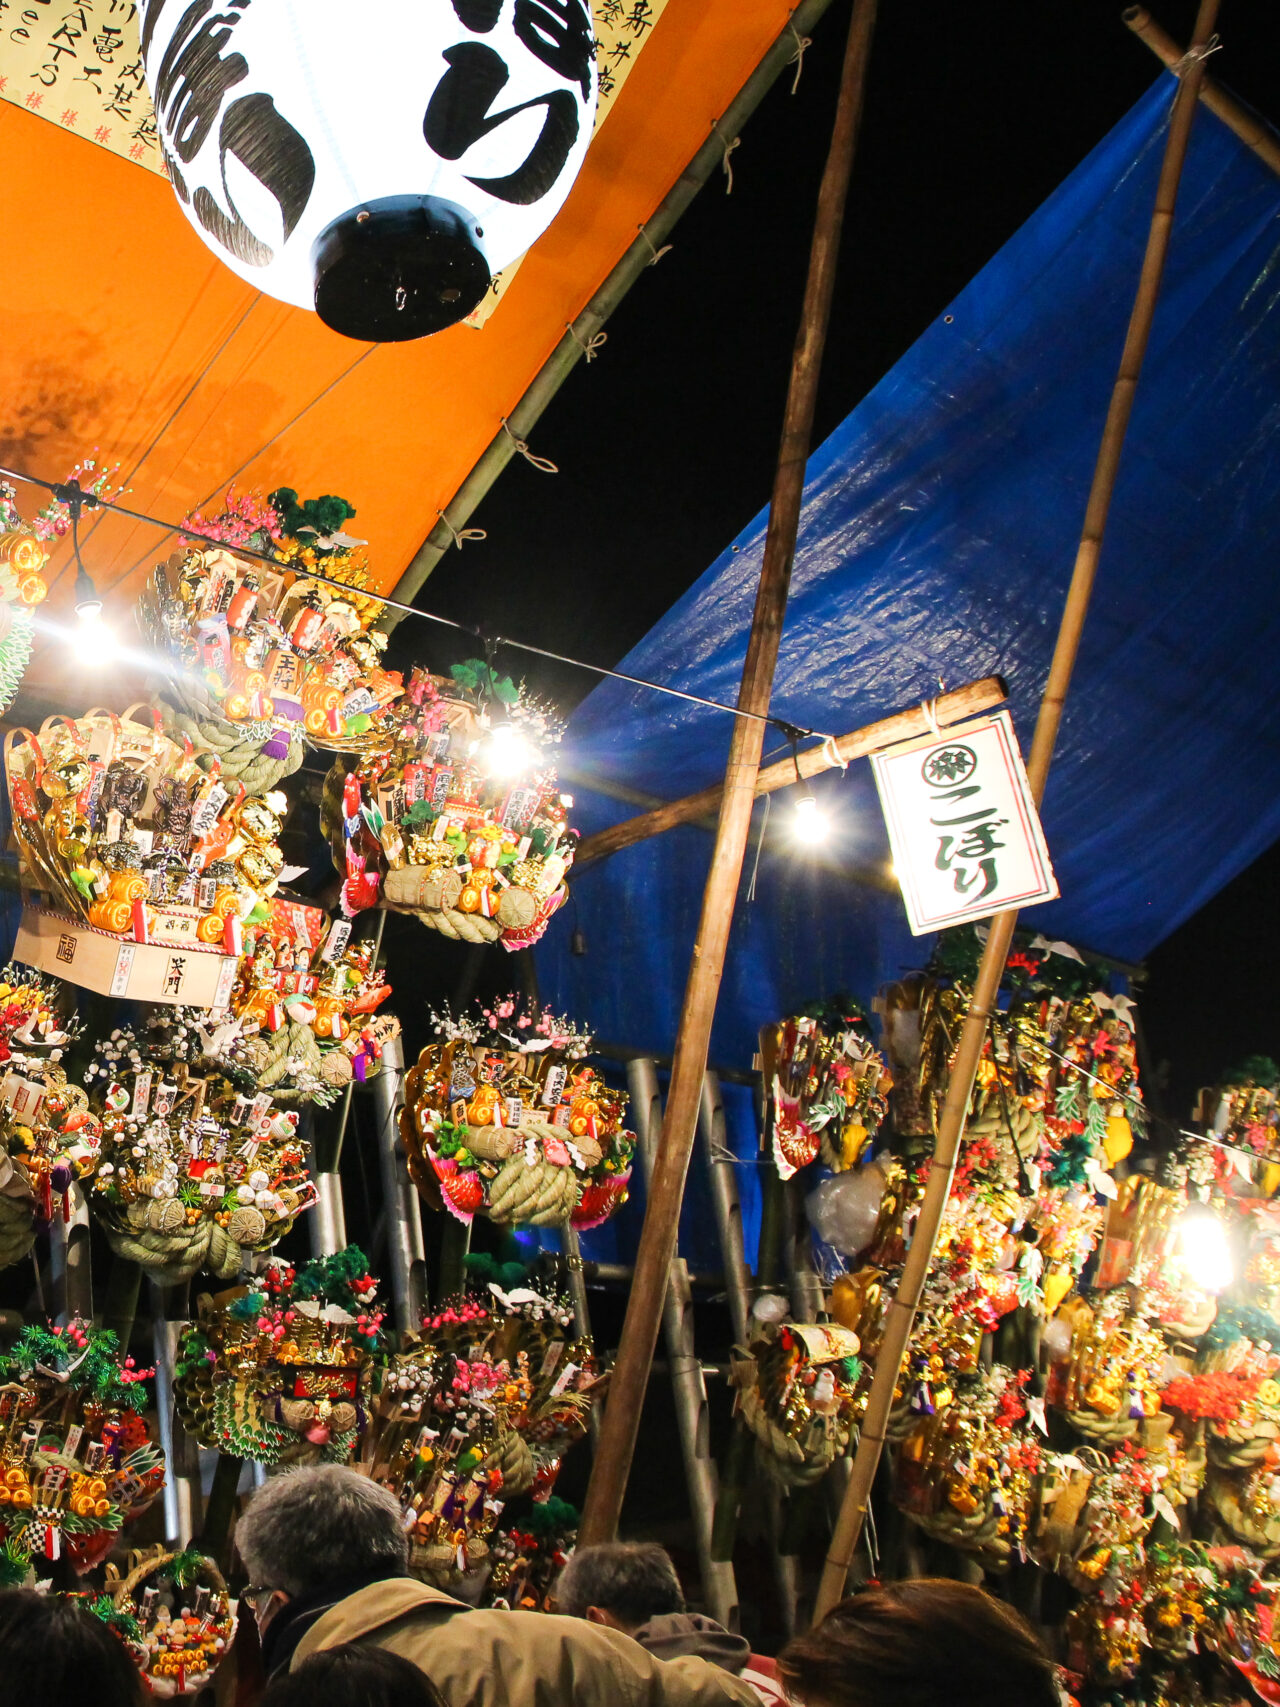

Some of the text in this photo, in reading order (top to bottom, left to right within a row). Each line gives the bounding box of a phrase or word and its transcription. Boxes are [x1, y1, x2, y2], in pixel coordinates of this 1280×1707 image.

[274, 654, 297, 690] 王将
[929, 784, 1010, 908] こぼり
[57, 933, 78, 964] 福
[164, 956, 187, 996] 笑門
